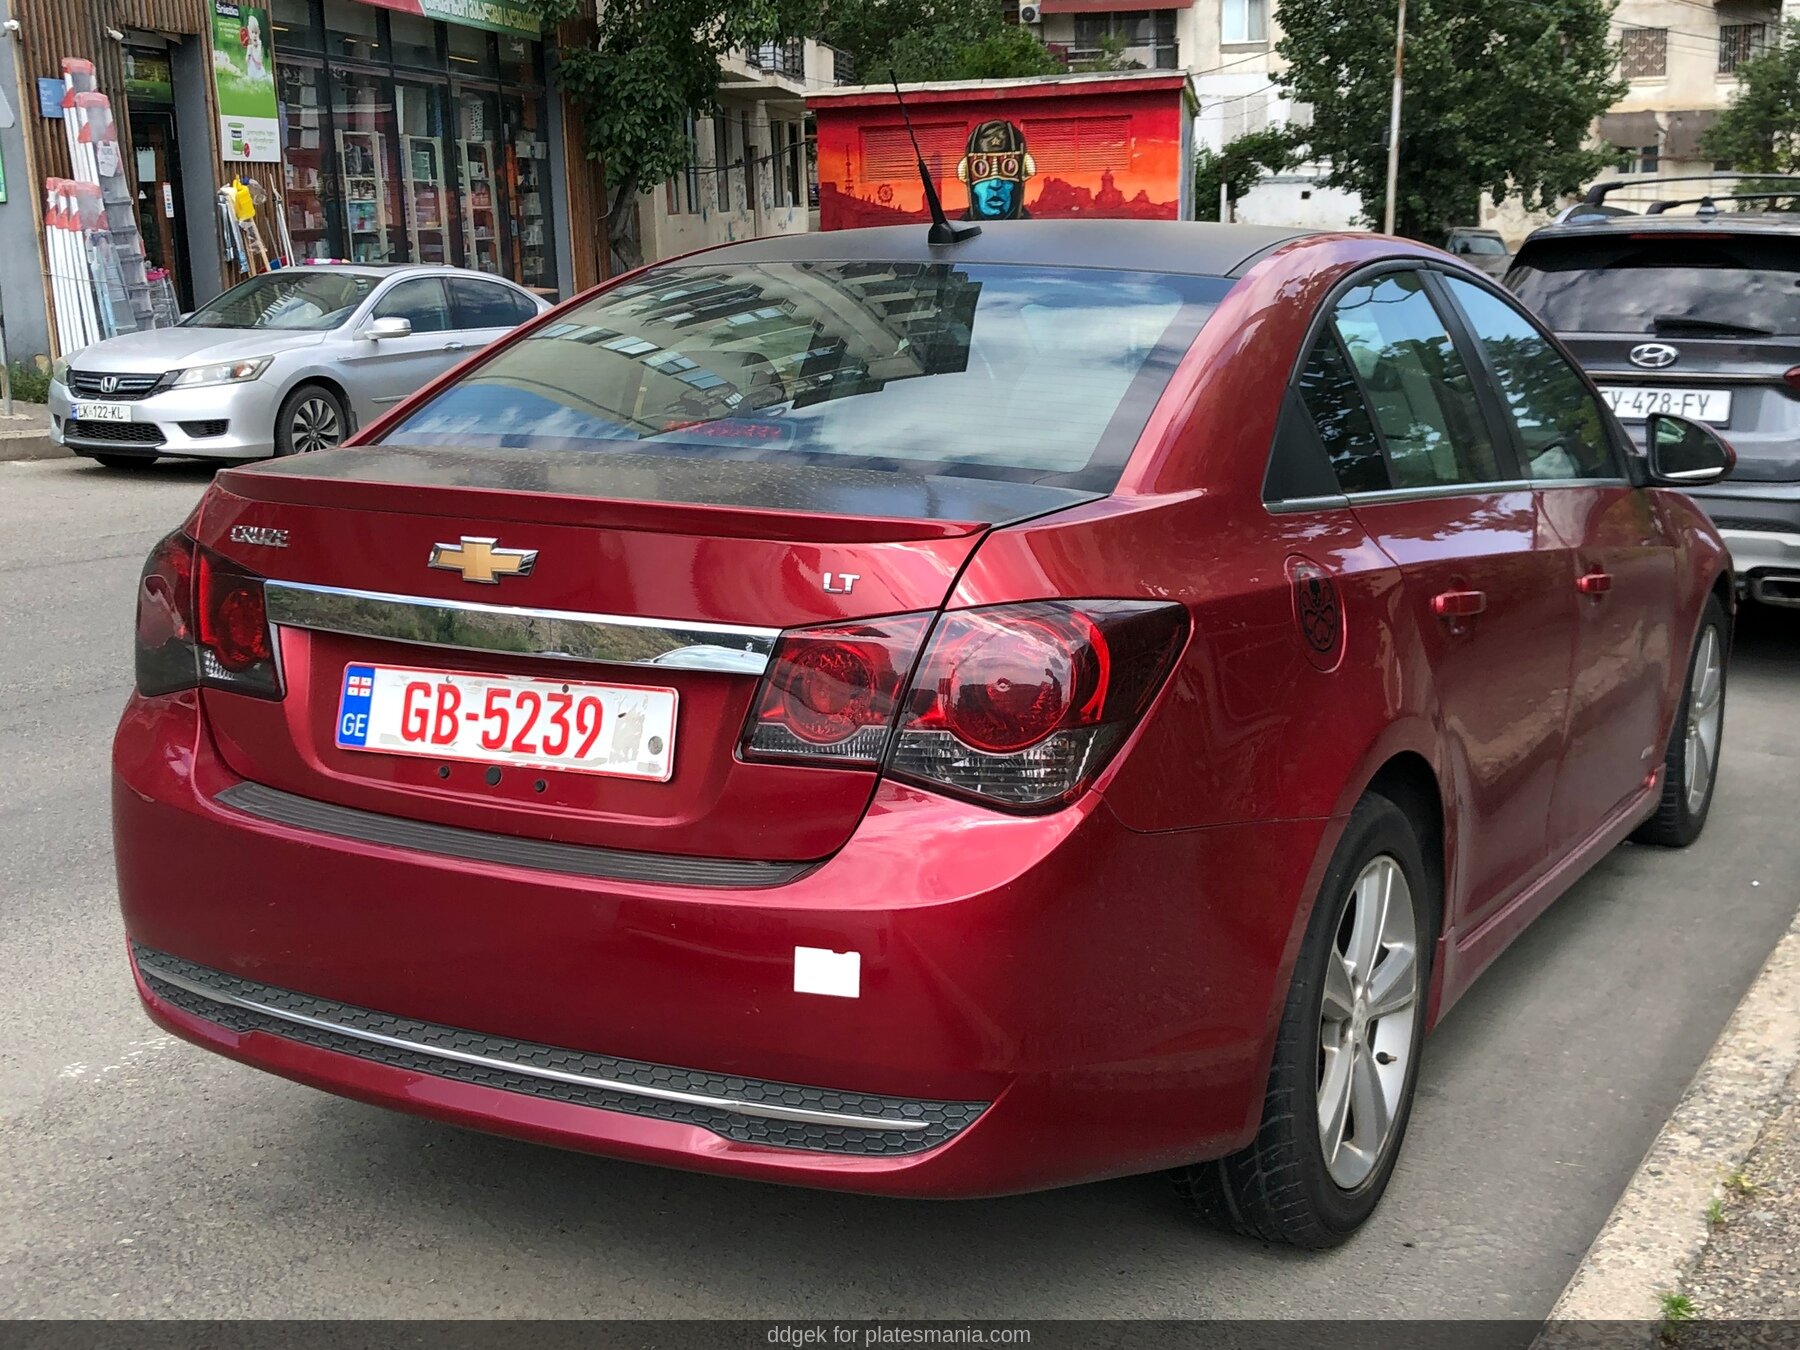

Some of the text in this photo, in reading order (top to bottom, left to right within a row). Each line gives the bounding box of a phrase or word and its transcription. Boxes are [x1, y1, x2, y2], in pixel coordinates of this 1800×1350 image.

[78, 405, 124, 420] LK-122-KL
[230, 525, 290, 548] CRUZE
[823, 572, 861, 595] LT
[342, 712, 367, 738] GE
[400, 681, 605, 759] GB-5239
